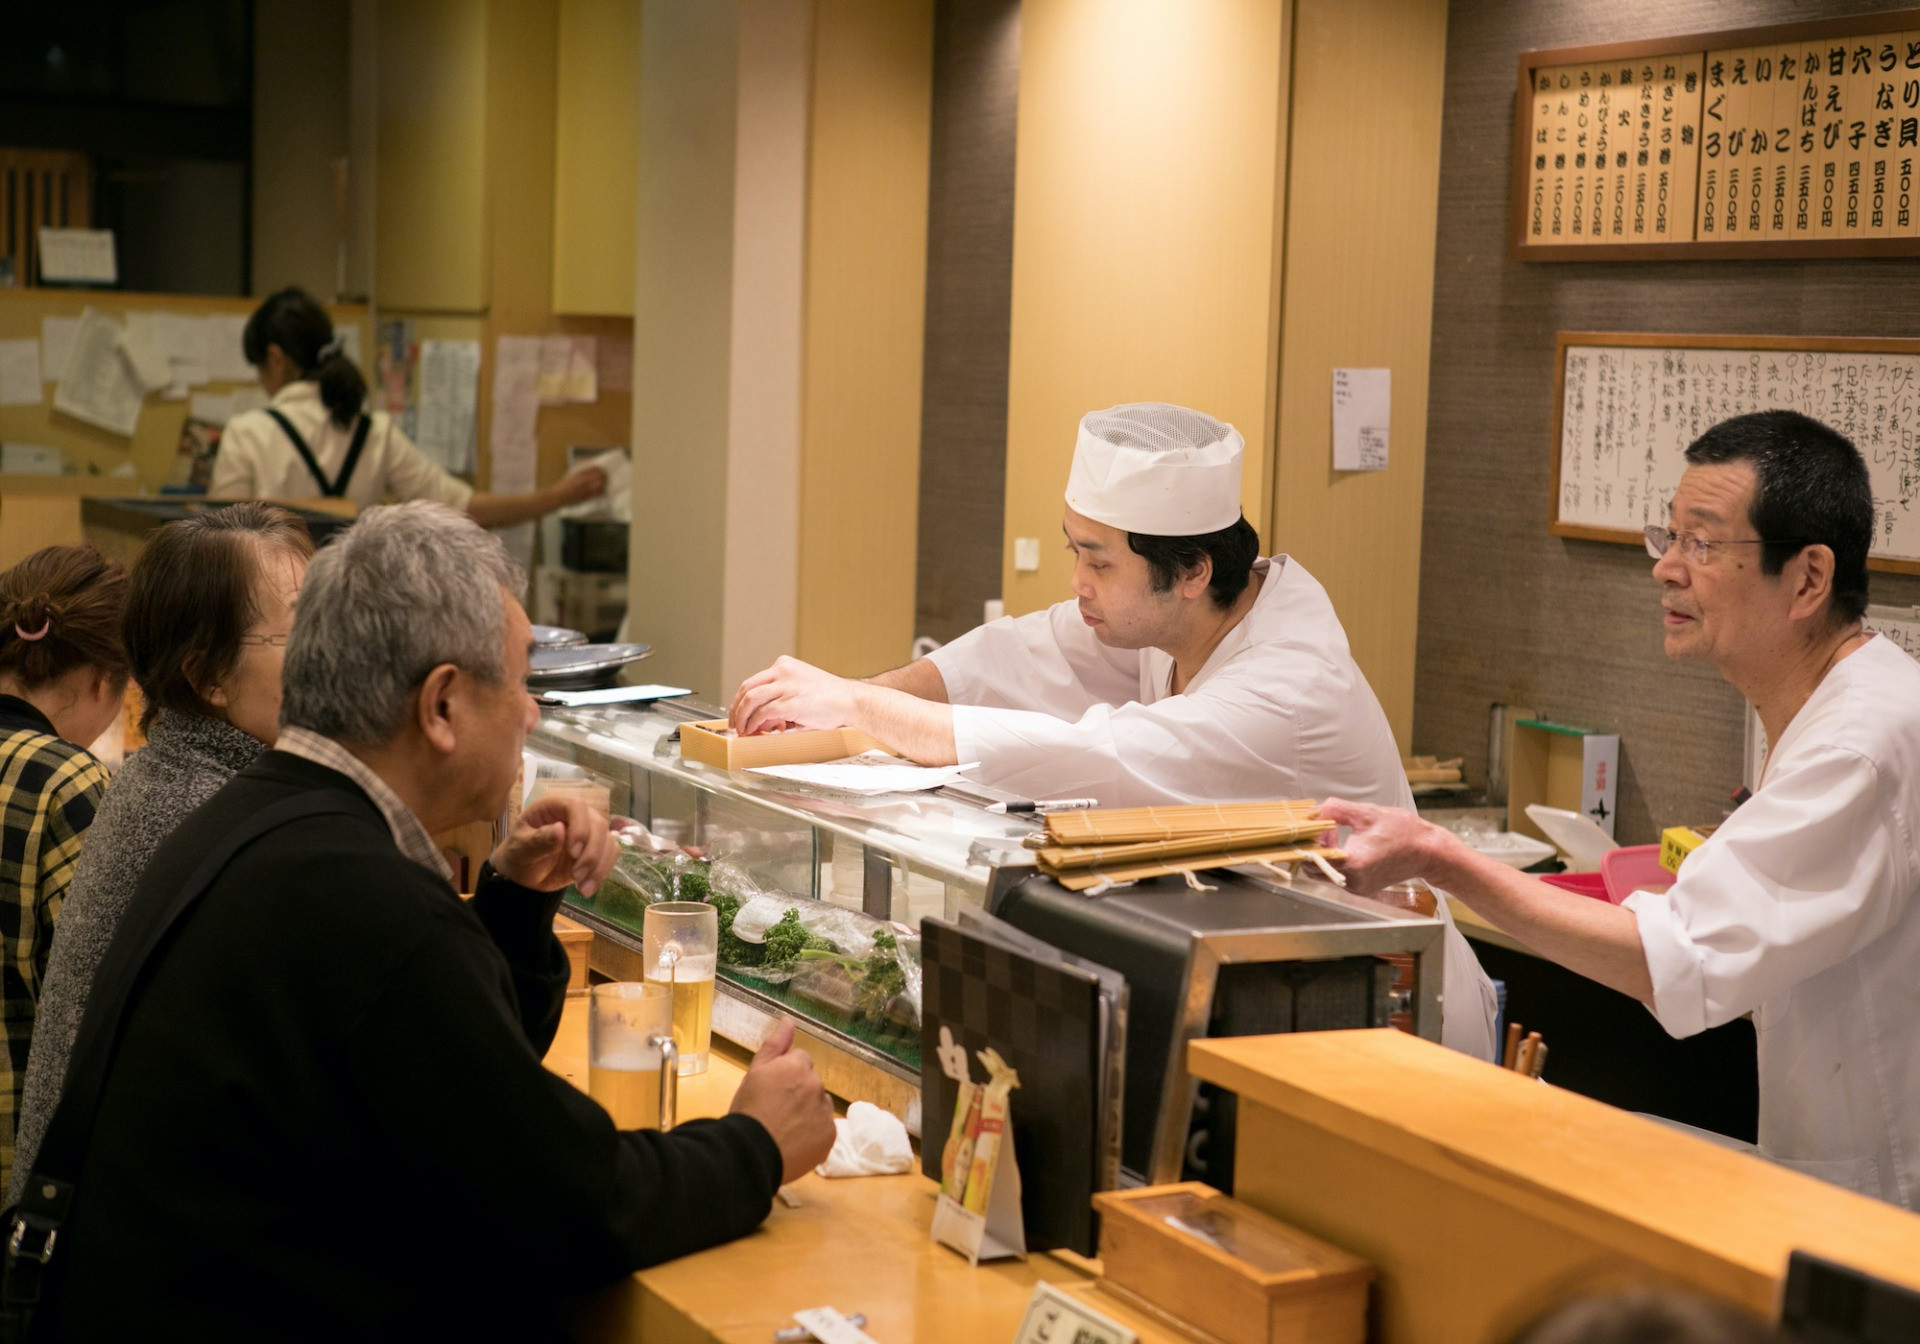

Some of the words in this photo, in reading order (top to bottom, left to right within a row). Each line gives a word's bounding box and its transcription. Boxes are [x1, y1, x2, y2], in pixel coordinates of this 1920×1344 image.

[1681, 72, 1697, 145] 巻物
[1705, 61, 1725, 160] まぐろ
[1728, 59, 1748, 157] えび
[1751, 58, 1771, 155] いか
[1775, 54, 1796, 153] たこ
[1823, 47, 1846, 150] 甘えび
[1848, 46, 1872, 150] 穴子
[1874, 44, 1897, 148] うなぎ
[1898, 42, 1920, 148] とり貝
